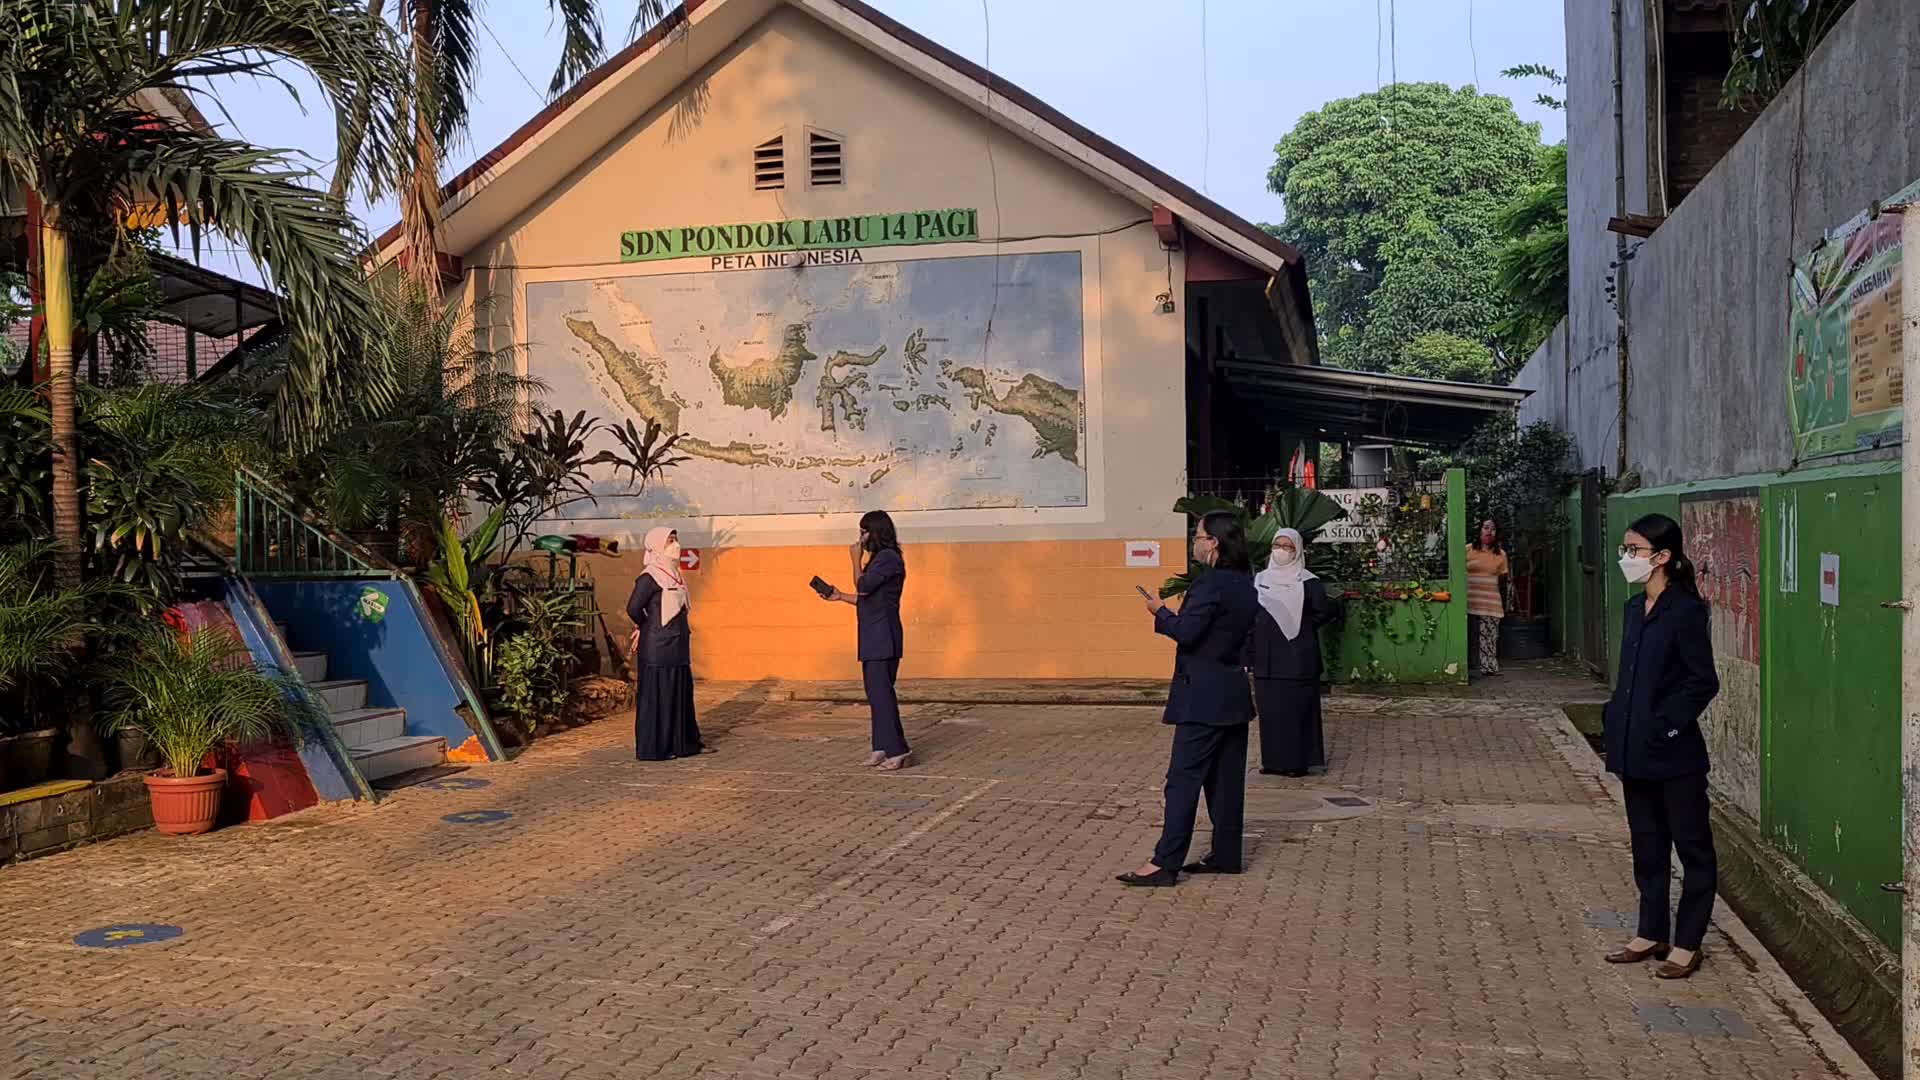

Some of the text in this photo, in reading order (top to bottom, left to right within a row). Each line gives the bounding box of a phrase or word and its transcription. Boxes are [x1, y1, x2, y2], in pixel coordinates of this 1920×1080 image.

[620, 208, 978, 257] SDN PONDOK LABU 14 PAGI
[711, 254, 757, 270] PETA
[1331, 527, 1378, 538] SEKOLA
